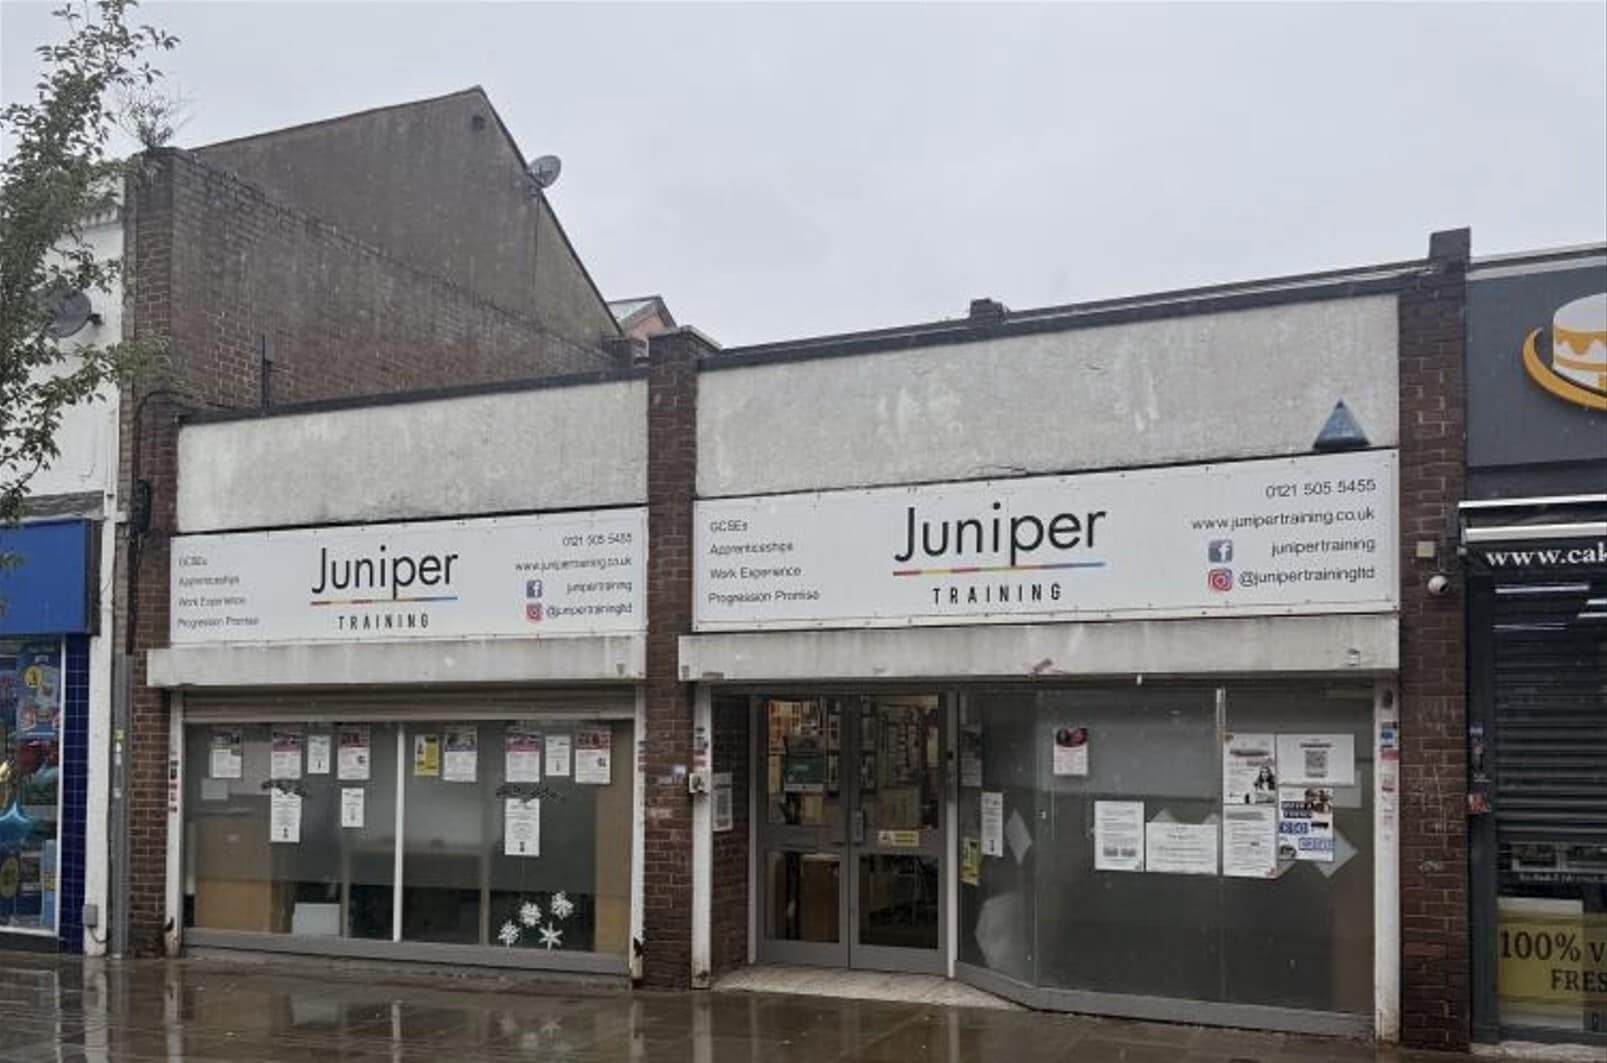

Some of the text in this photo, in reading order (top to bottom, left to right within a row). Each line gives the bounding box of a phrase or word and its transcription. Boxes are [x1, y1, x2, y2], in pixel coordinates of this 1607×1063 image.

[1265, 478, 1377, 499] 0121 505 5455
[1191, 507, 1375, 531] www.junipertraining.co.uk
[894, 502, 1107, 566] Juniper
[1271, 537, 1376, 557] junipertraining
[311, 545, 459, 600] Juniper
[1238, 565, 1376, 588] @junipertrainingltd
[933, 583, 1061, 604] TRAINING
[338, 613, 430, 630] TRAINING
[1501, 931, 1581, 962] 100%
